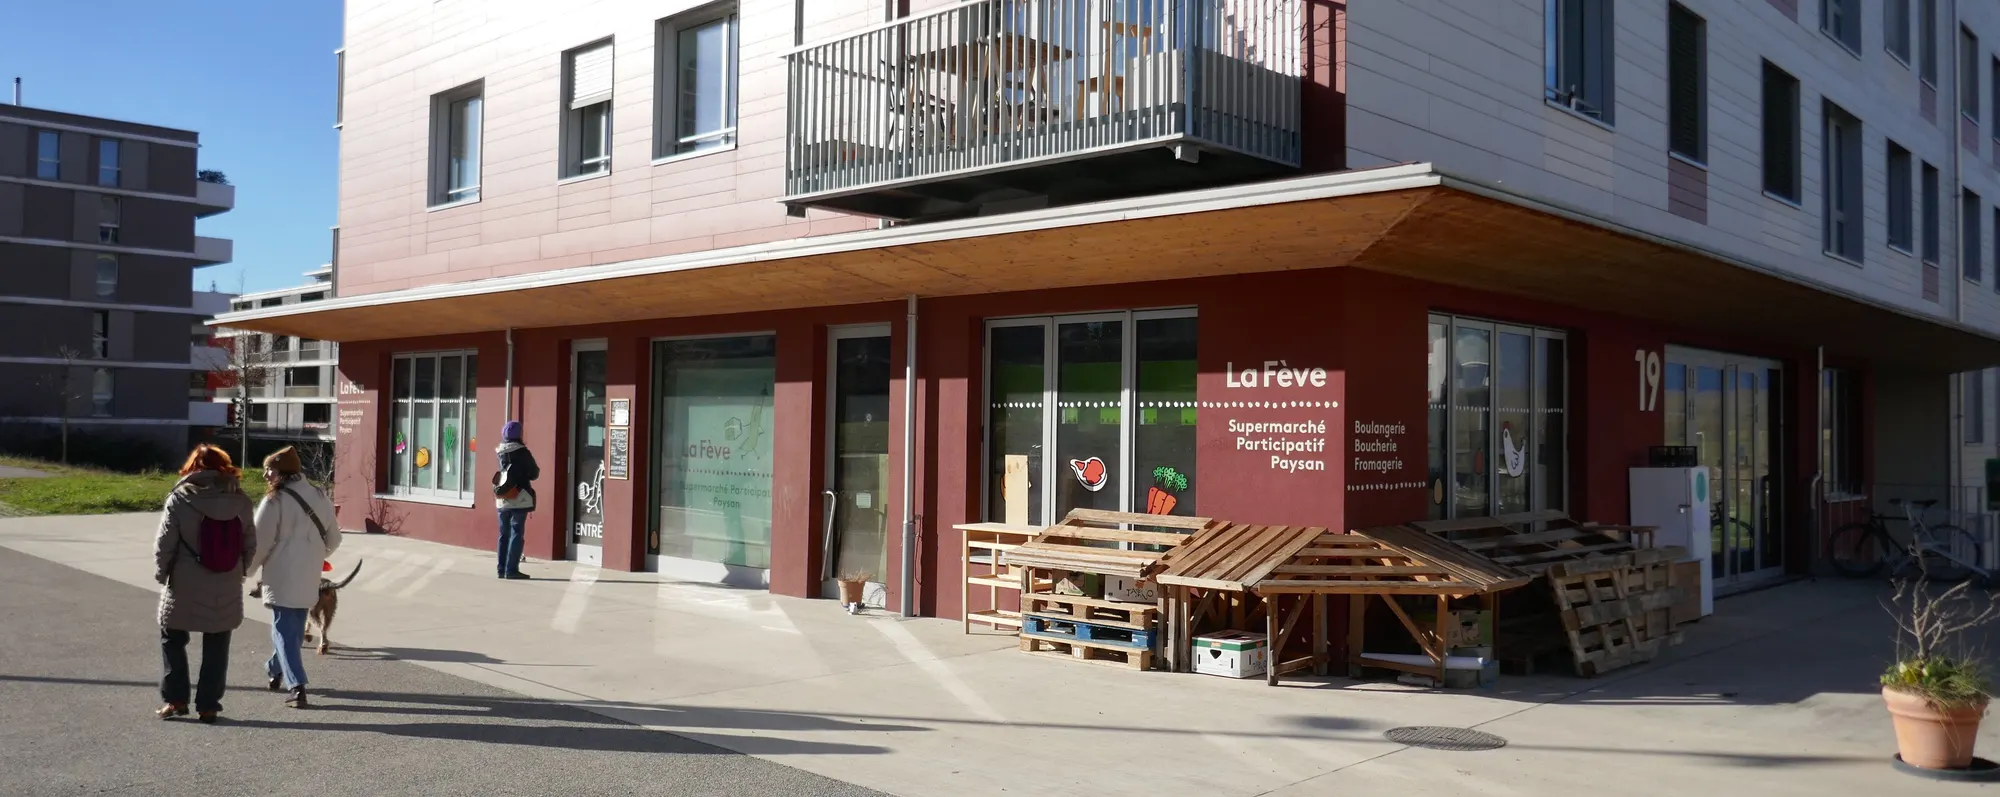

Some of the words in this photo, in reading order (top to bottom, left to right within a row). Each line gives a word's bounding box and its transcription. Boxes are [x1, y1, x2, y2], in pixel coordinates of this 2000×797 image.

[1226, 361, 1258, 388] La
[1263, 359, 1327, 388] Fève
[1635, 349, 1660, 412] 19
[340, 381, 349, 394] La
[1228, 419, 1326, 436] Supermarché
[1354, 420, 1406, 438] Boulangerie
[682, 439, 697, 459] La
[700, 439, 731, 461] Fève
[1236, 437, 1325, 455] Participatif
[1354, 439, 1397, 453] Boucherie
[1271, 456, 1325, 473] Paysan
[1354, 456, 1403, 474] Fromagerie
[713, 497, 740, 509] Paysan
